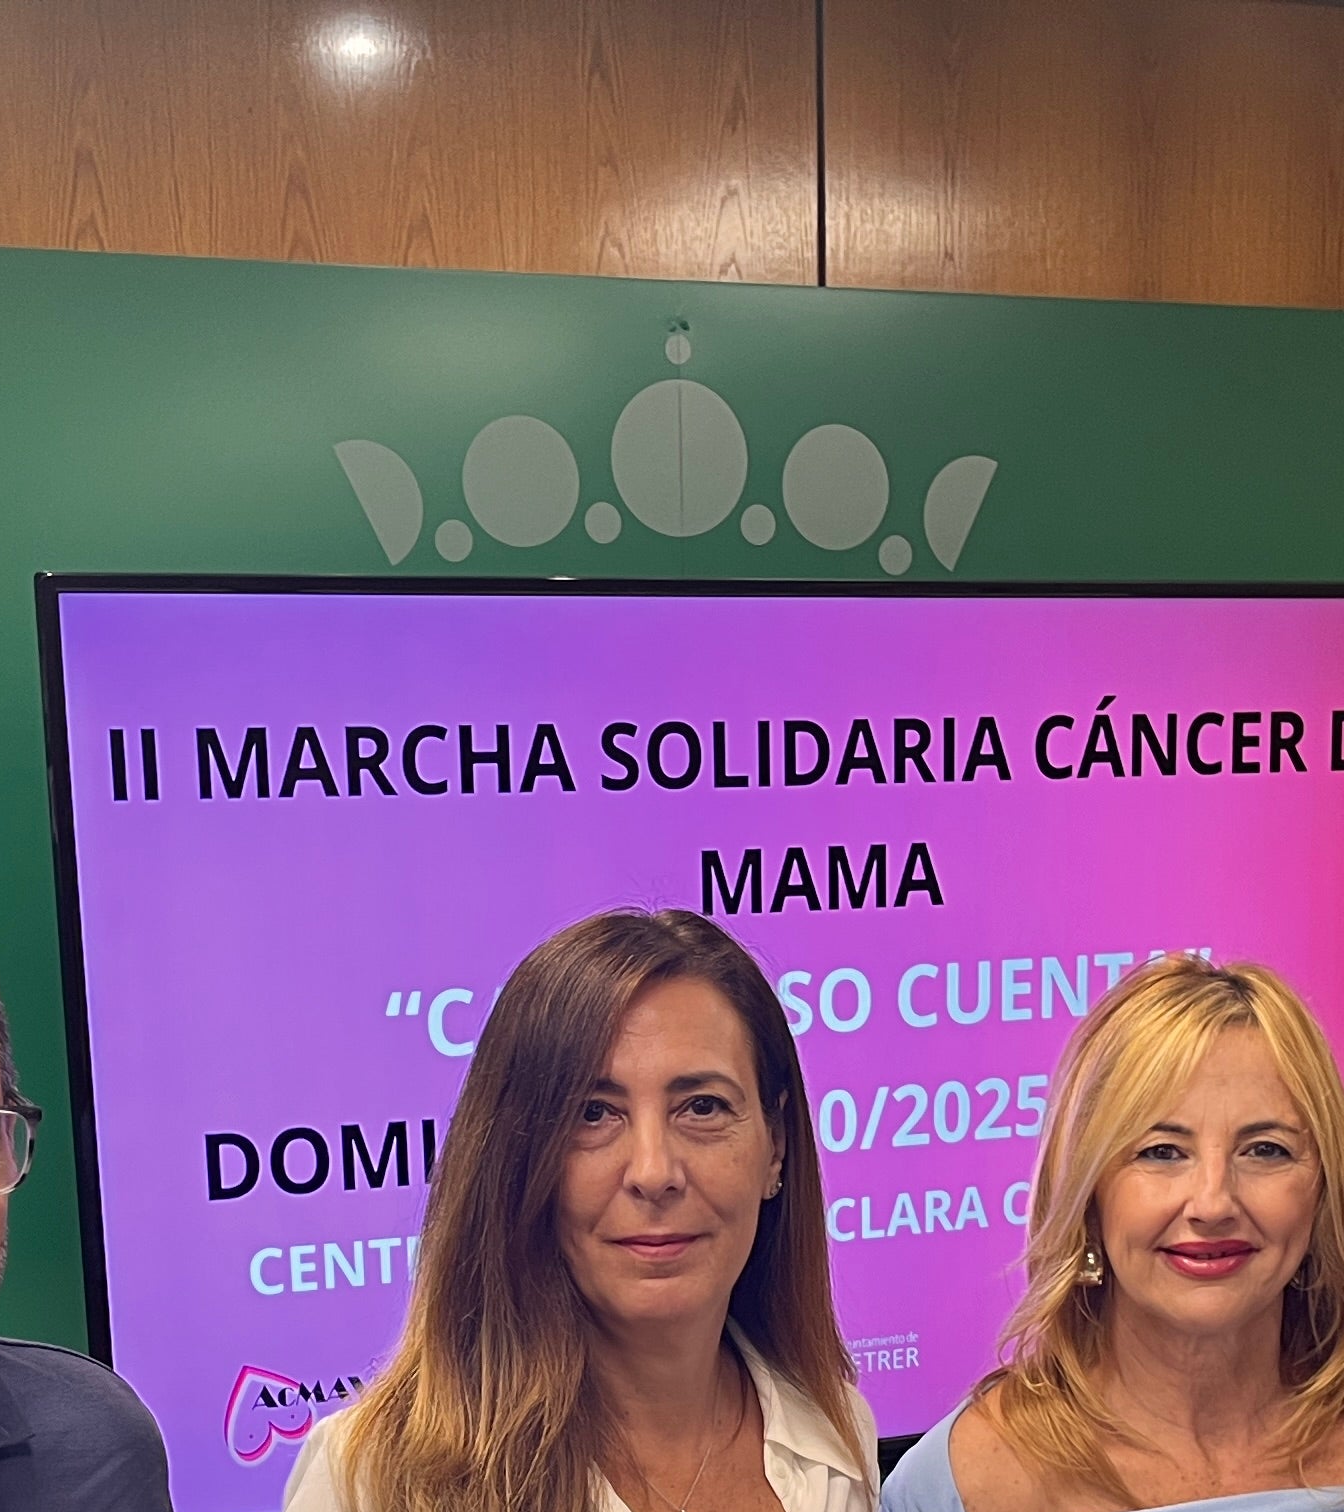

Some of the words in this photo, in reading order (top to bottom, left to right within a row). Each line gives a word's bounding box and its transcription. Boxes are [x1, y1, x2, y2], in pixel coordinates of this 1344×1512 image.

[108, 726, 160, 802] II
[195, 723, 577, 801] MARCHA
[600, 716, 1012, 792] SOLIDARIA
[1034, 695, 1308, 780] CÁNCER
[700, 842, 945, 916] MAMA
[204, 1118, 438, 1202] DOMI
[818, 1073, 1050, 1154] 0/2025
[249, 1236, 420, 1296] CENT
[827, 1185, 989, 1243] CLARA
[854, 1346, 920, 1373] ETRER
